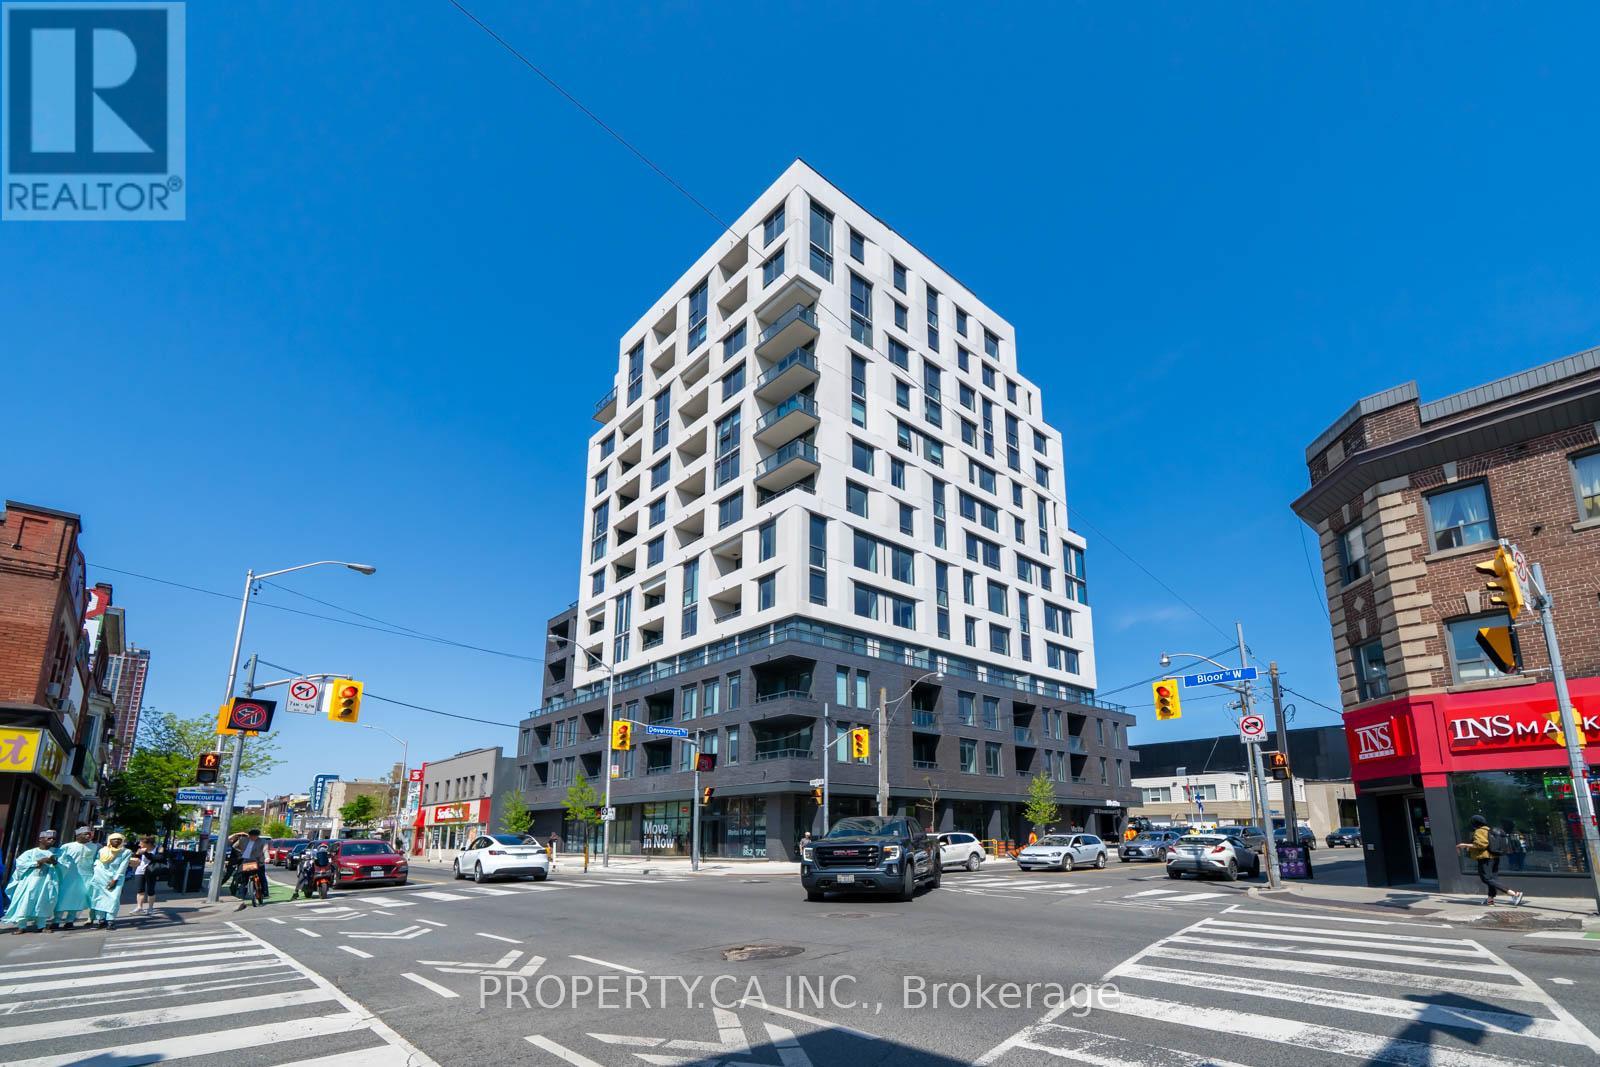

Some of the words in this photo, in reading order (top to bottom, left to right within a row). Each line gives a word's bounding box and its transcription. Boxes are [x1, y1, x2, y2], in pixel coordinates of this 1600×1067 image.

[1197, 673, 1224, 684] Bloor
[1232, 669, 1242, 679] W
[648, 726, 683, 736] Dovercourt
[1450, 714, 1514, 740] INS
[1515, 715, 1600, 736] MAK
[1356, 726, 1392, 754] INS
[179, 793, 215, 801] Dovercourt
[643, 821, 669, 834] Move
[642, 835, 652, 849] in
[653, 835, 675, 849] Now
